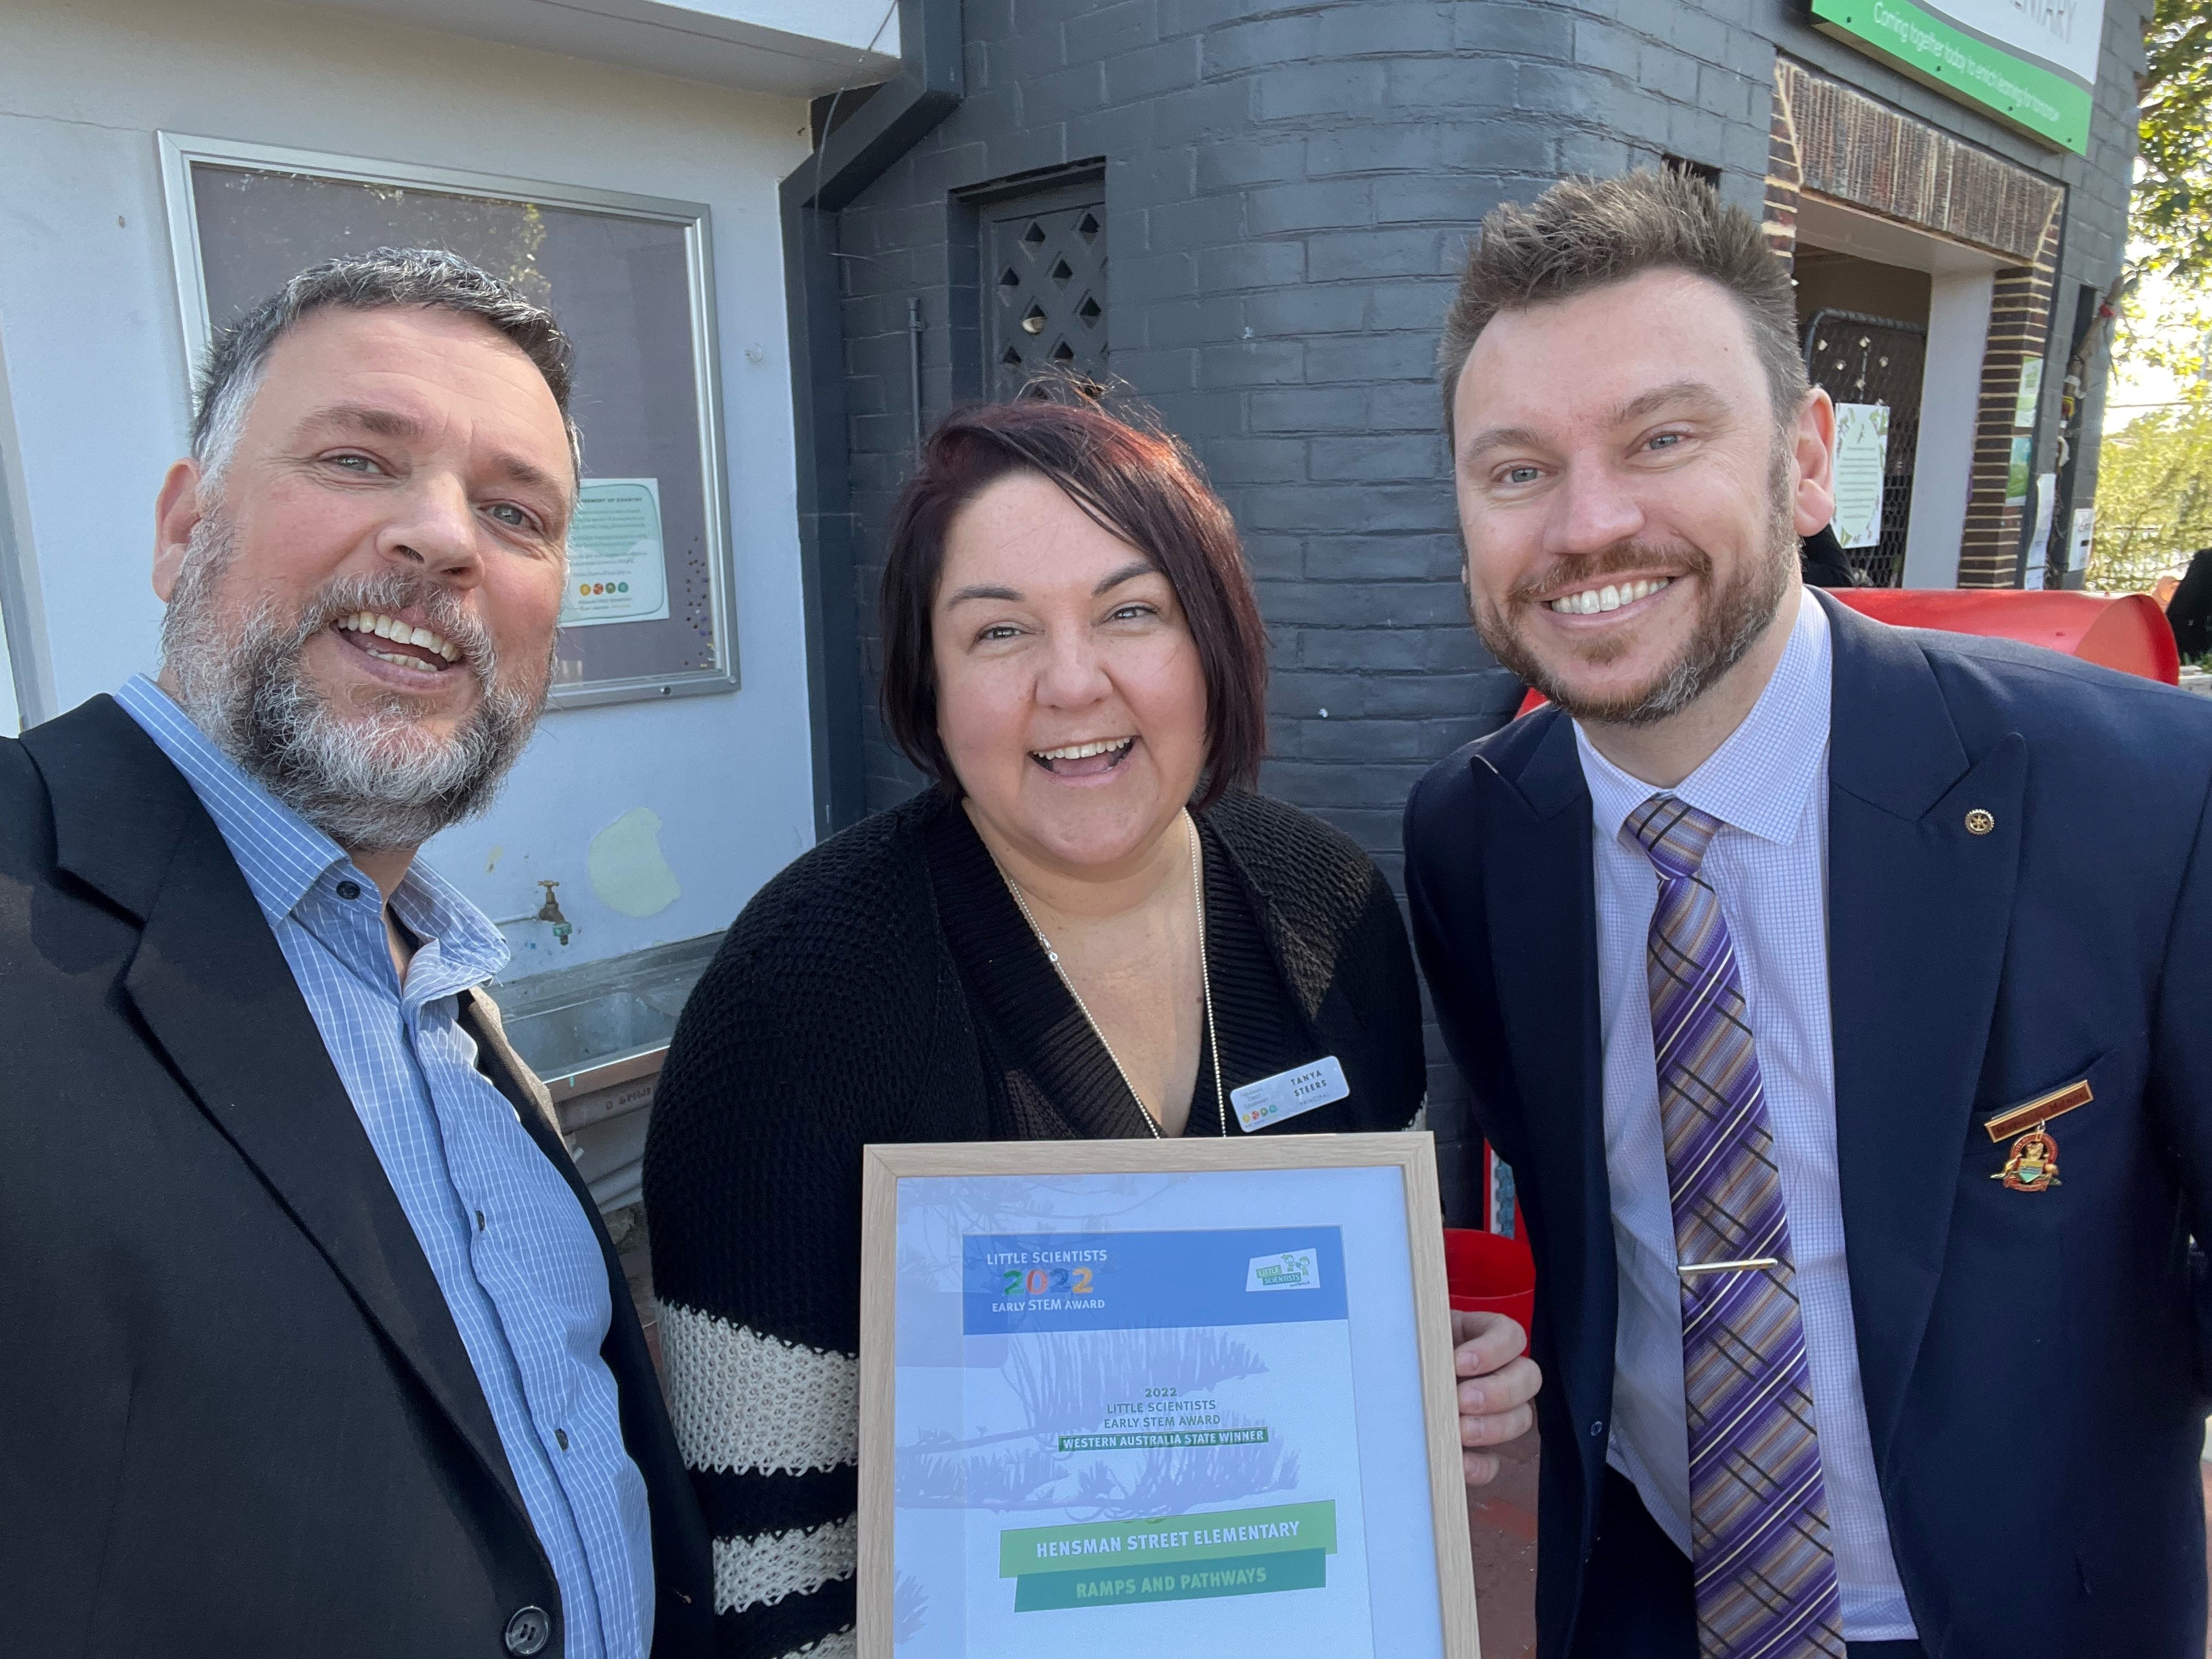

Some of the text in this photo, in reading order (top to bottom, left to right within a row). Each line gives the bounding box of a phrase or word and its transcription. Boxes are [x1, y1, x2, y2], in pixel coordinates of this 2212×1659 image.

[1291, 1070, 1322, 1086] TANYA
[1294, 1080, 1327, 1097] STEERS
[1300, 1092, 1330, 1107] PRINCIPAL
[988, 1250, 1107, 1265] LITTLE SCIENTISTS
[1259, 1267, 1280, 1277] LITTLE
[1265, 1274, 1300, 1284] SCIENTISTS
[1003, 1267, 1093, 1295] 2022
[992, 1299, 1105, 1312] EARLY STEM AWARD
[1145, 1387, 1177, 1398] 2022
[1107, 1400, 1216, 1414] LITTLE SCIENTISTS
[1104, 1415, 1220, 1429] EARLY STEM AWARD
[1063, 1430, 1263, 1449] WESTERN AUSTRALIA STATE WINNER
[1037, 1521, 1299, 1558] HENSMAN STREET ELEMENTARY
[1076, 1567, 1266, 1598] RAMPS AND PATHWAYS
